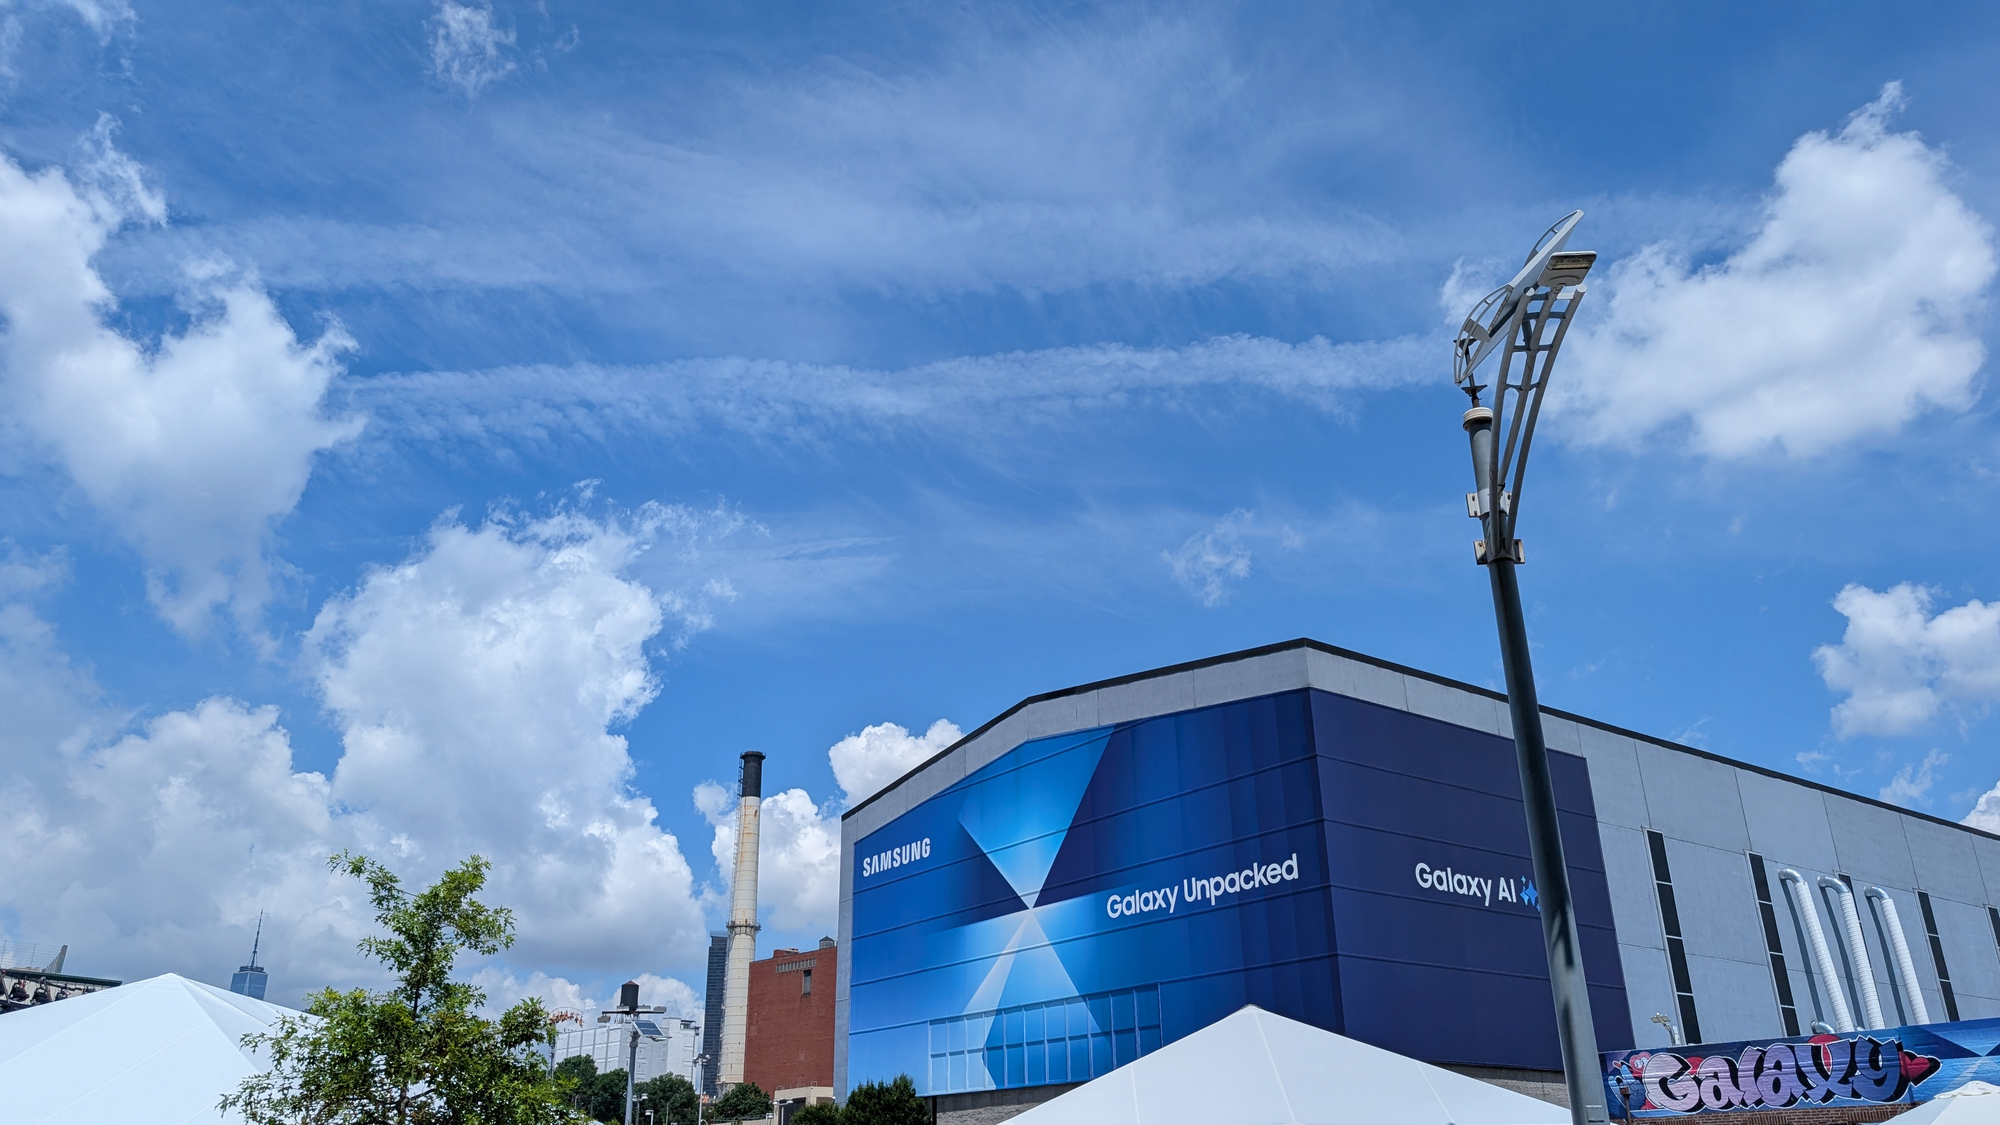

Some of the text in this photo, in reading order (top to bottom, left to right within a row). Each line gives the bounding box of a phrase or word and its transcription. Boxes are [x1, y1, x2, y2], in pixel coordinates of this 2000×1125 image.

[863, 838, 931, 877] SAMSUNG
[1107, 853, 1299, 919] Galaxy Unpacked
[1415, 862, 1517, 907] Galaxy AI
